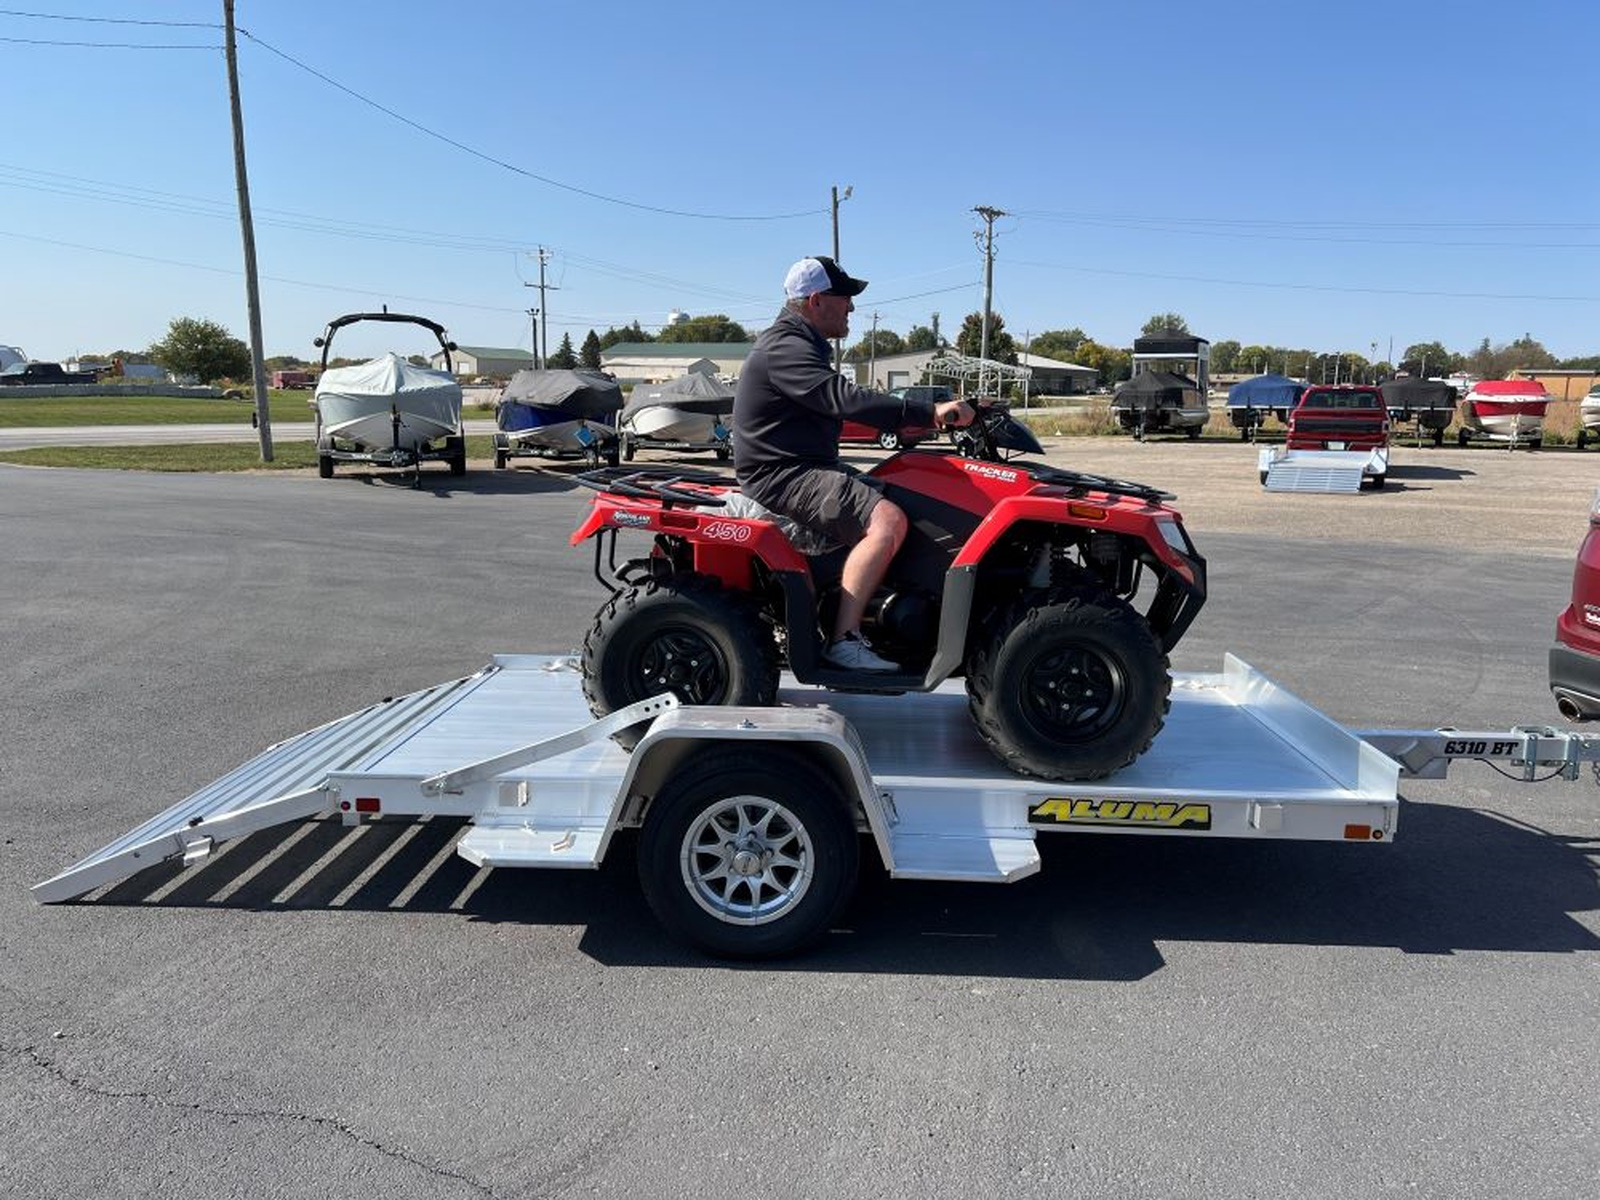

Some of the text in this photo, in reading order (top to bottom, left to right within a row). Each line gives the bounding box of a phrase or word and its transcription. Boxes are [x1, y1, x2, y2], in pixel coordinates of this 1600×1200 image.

[964, 463, 1017, 479] TRACKER
[703, 520, 751, 542] 450
[1444, 741, 1519, 756] 6310 BT
[1029, 797, 1211, 828] ALUMA
